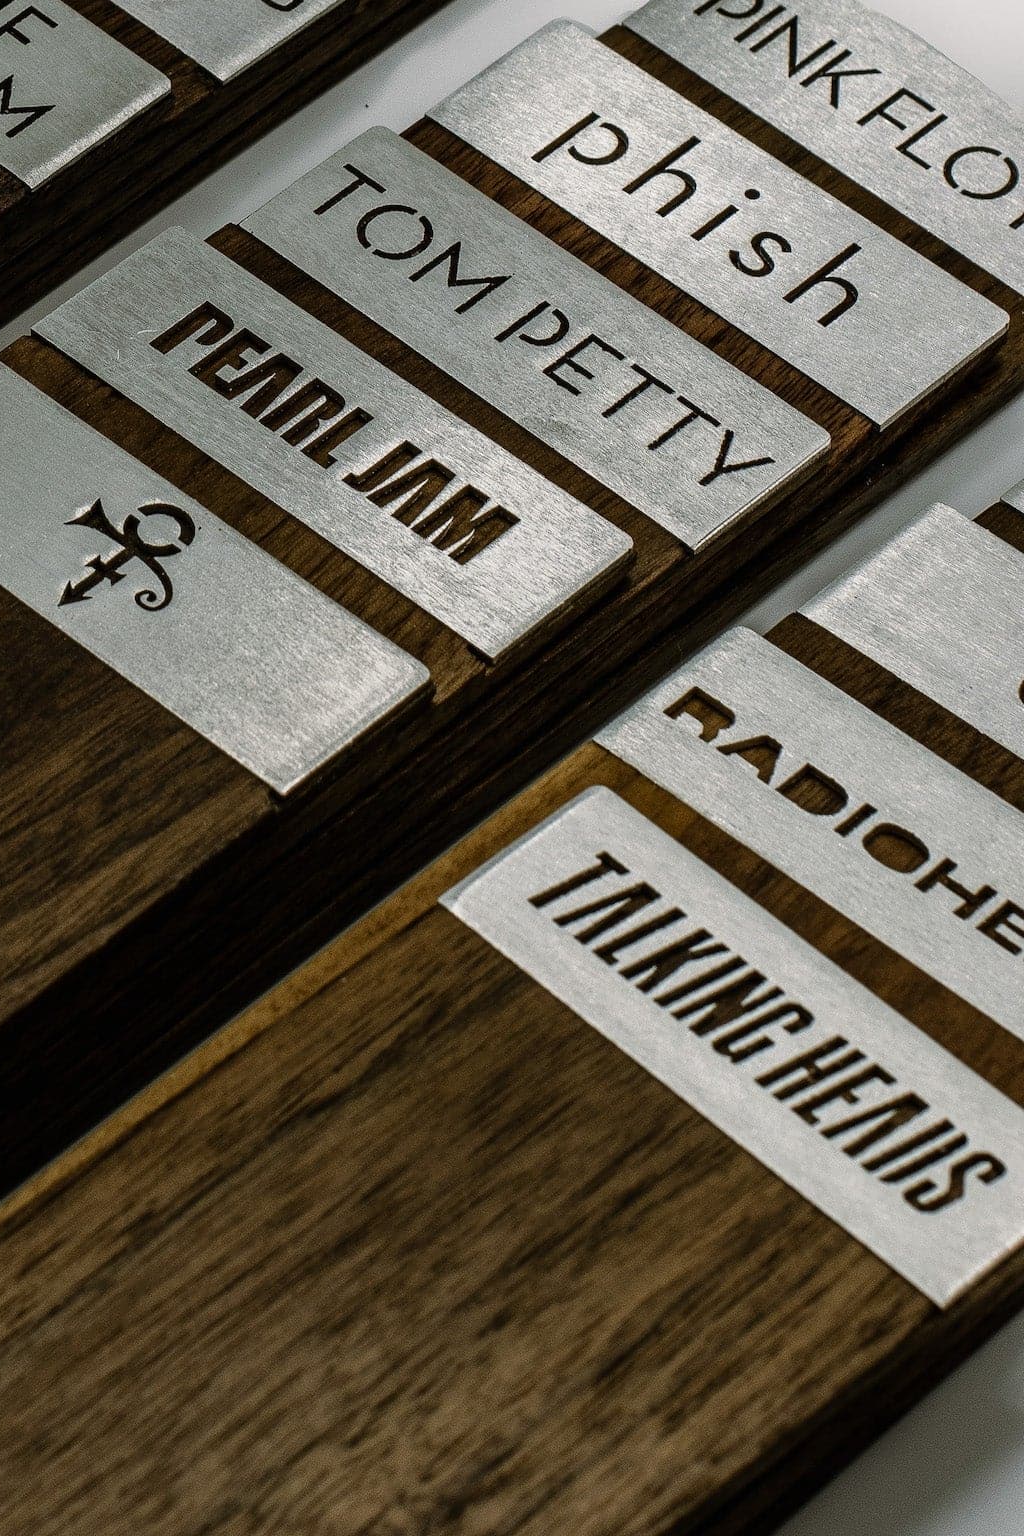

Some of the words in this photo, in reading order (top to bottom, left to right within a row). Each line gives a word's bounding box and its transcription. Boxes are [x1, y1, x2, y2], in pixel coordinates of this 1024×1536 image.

[313, 165, 511, 315] TOM
[495, 300, 774, 487] PETTY
[531, 111, 863, 328] phish
[149, 301, 374, 469] PEARL
[342, 440, 520, 565] JAM
[527, 851, 814, 1064] TALKING
[754, 1036, 1007, 1213] HEADS
